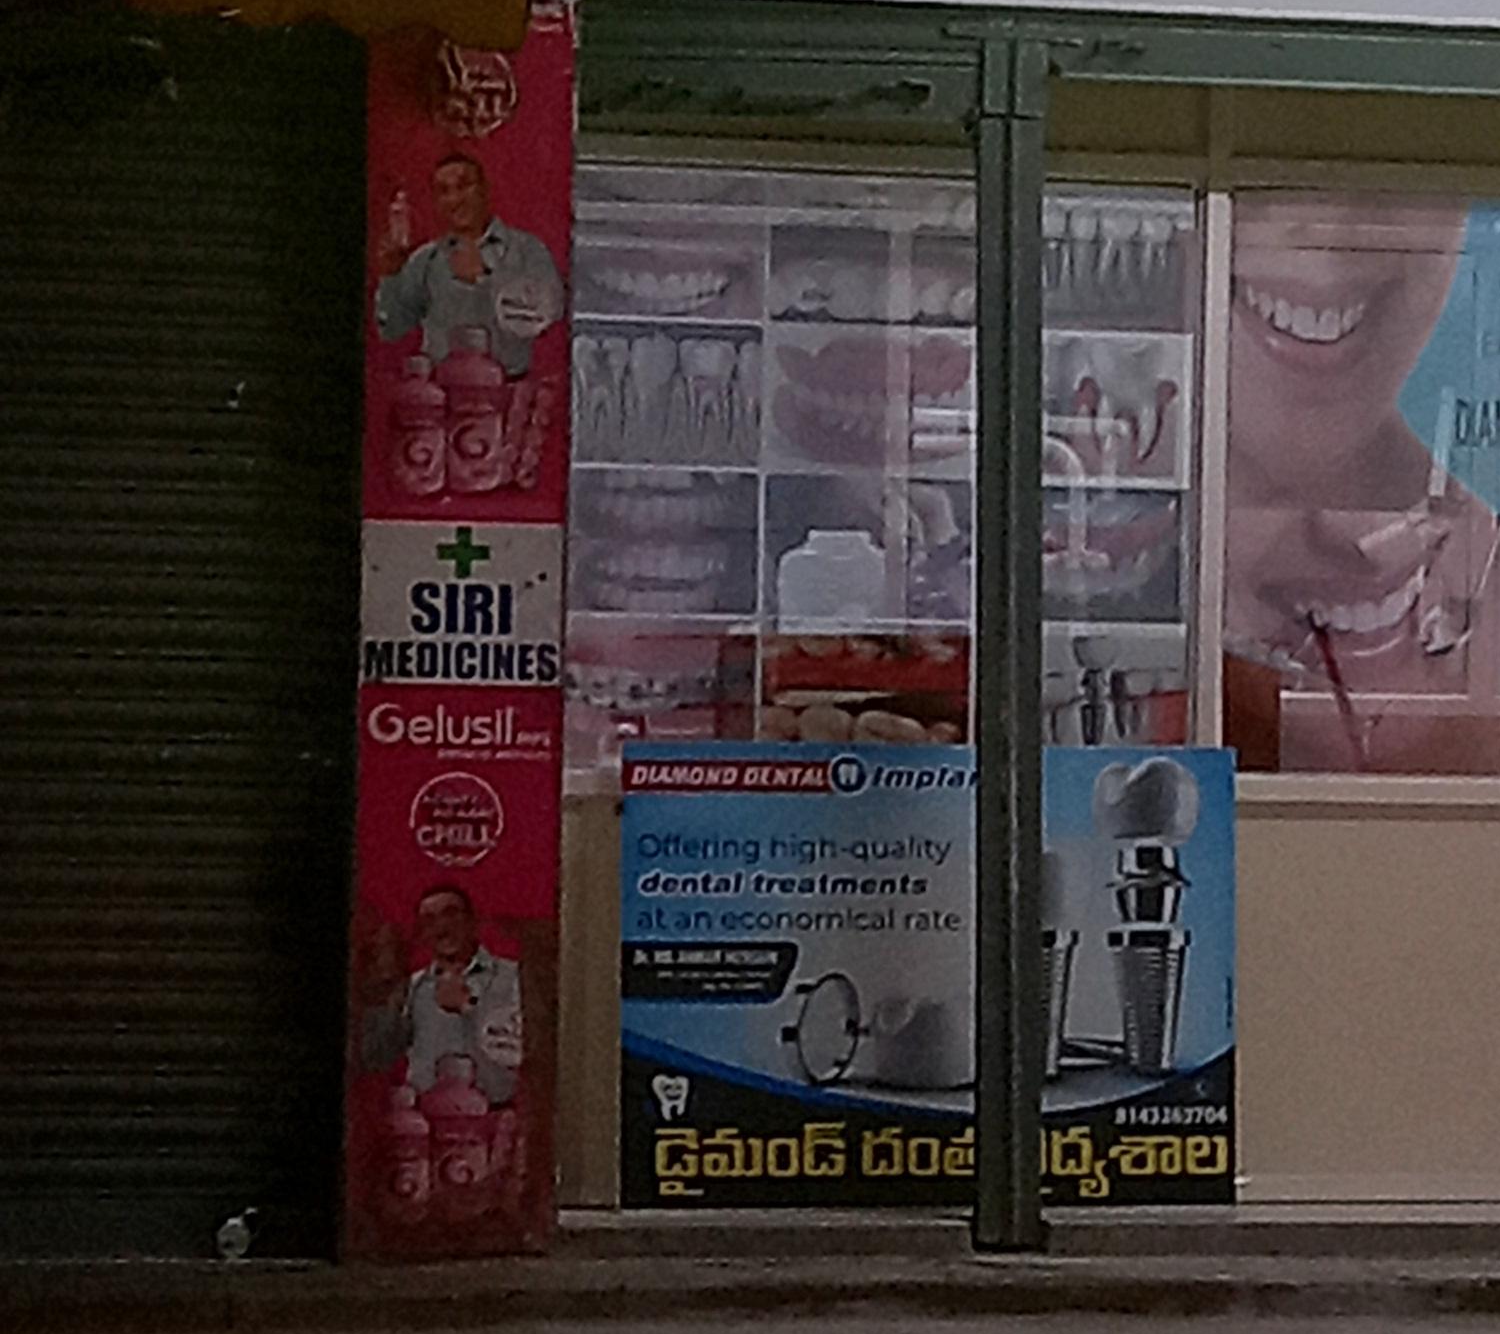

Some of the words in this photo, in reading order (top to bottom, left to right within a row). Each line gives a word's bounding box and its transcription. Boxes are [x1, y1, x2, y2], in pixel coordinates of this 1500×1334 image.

[410, 581, 513, 636] SIRI
[363, 640, 559, 683] MEDICINES
[367, 701, 515, 746] Gelusil
[629, 764, 739, 787] DIAMOND
[742, 765, 828, 788] DENTAL
[636, 832, 760, 864] Offering
[770, 835, 951, 865] high-quality
[639, 871, 743, 896] dental
[752, 871, 929, 896] treatments
[636, 908, 665, 932] at
[673, 913, 714, 933] an
[720, 907, 895, 932] economical
[653, 1120, 847, 1198] డైమండ్
[1040, 1124, 1229, 1199] ద్యశాల
